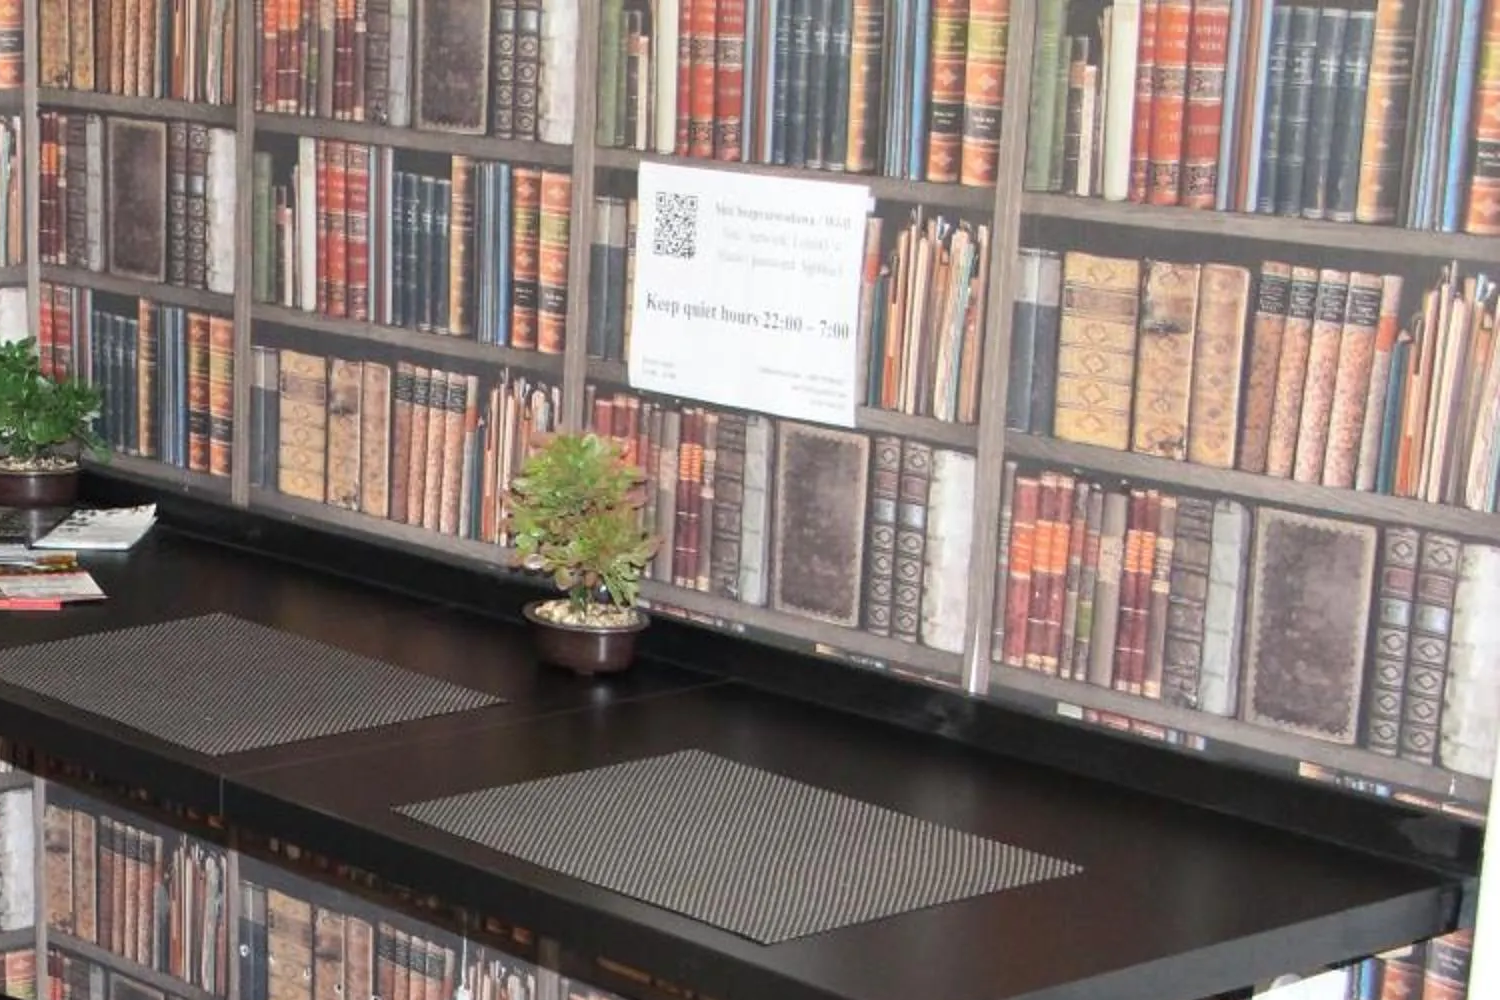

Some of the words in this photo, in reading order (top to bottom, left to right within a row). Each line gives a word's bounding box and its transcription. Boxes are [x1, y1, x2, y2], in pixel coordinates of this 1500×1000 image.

[646, 291, 680, 318] Keep
[683, 300, 718, 321] quiet
[721, 305, 759, 326] hours
[763, 310, 803, 332] 22:00
[820, 318, 850, 339] 7:00
